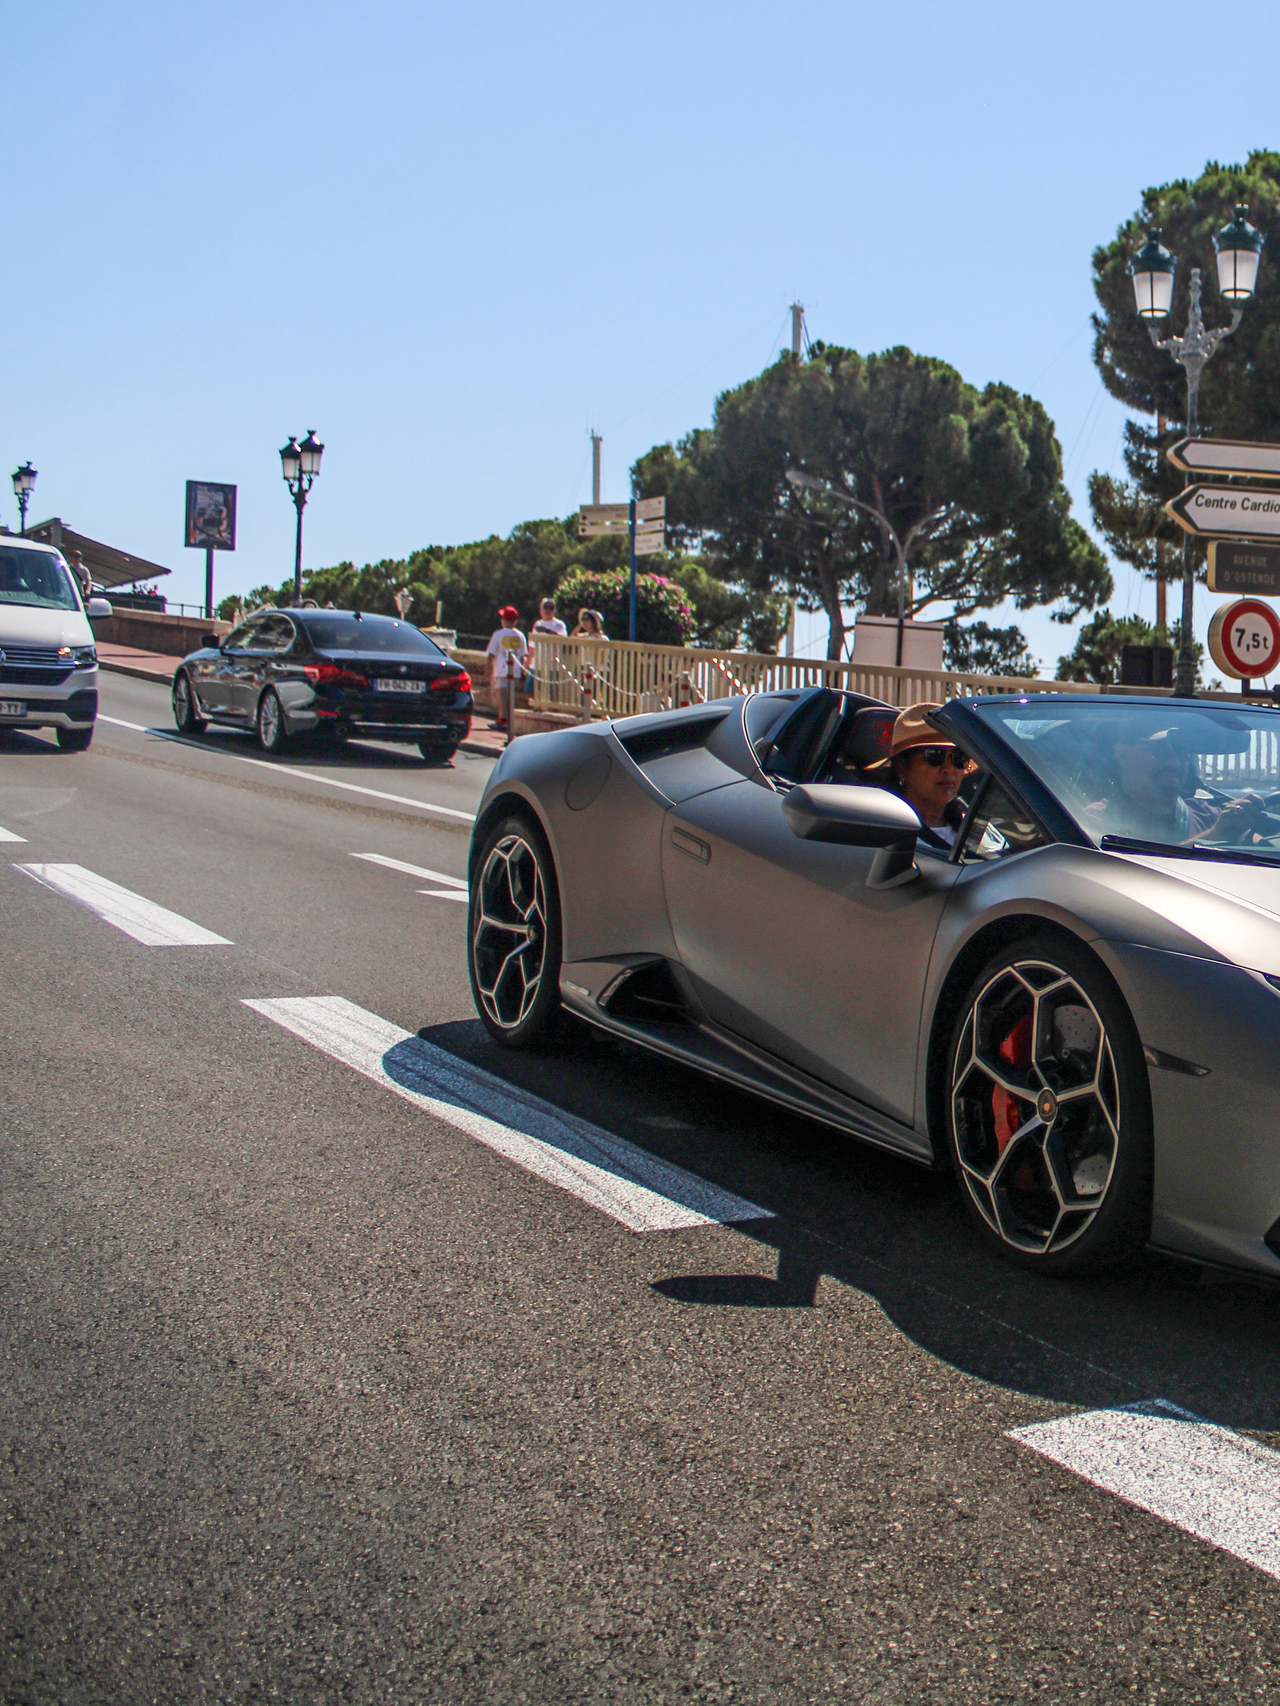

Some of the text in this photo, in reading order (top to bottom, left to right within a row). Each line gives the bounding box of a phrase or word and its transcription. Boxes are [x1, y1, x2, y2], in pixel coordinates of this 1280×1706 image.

[1194, 493, 1238, 510] Centre
[1232, 554, 1268, 568] AVENUE
[1223, 570, 1276, 585] D'OSTENDE
